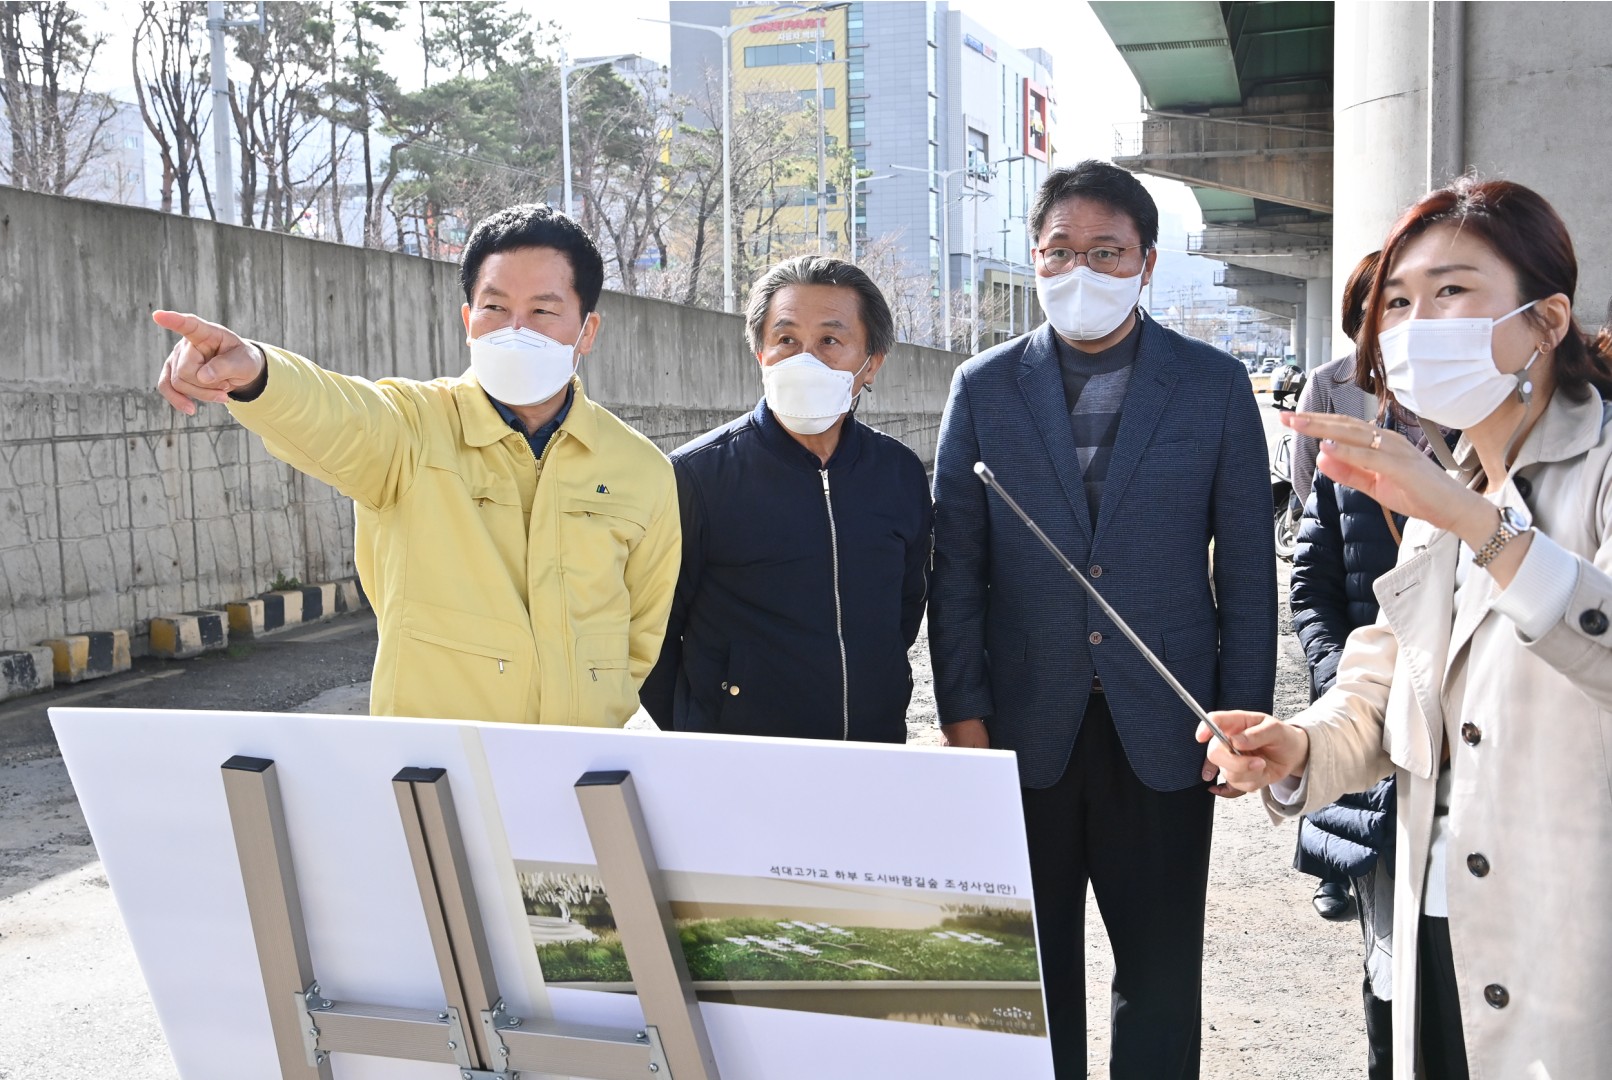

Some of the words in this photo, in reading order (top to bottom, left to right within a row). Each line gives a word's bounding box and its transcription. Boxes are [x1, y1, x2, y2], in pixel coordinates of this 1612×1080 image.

[769, 865, 829, 879] 석대고가교
[834, 870, 858, 881] 하부
[863, 872, 938, 889] 도시바람길숲
[944, 879, 1017, 895] 조성사업(안)
